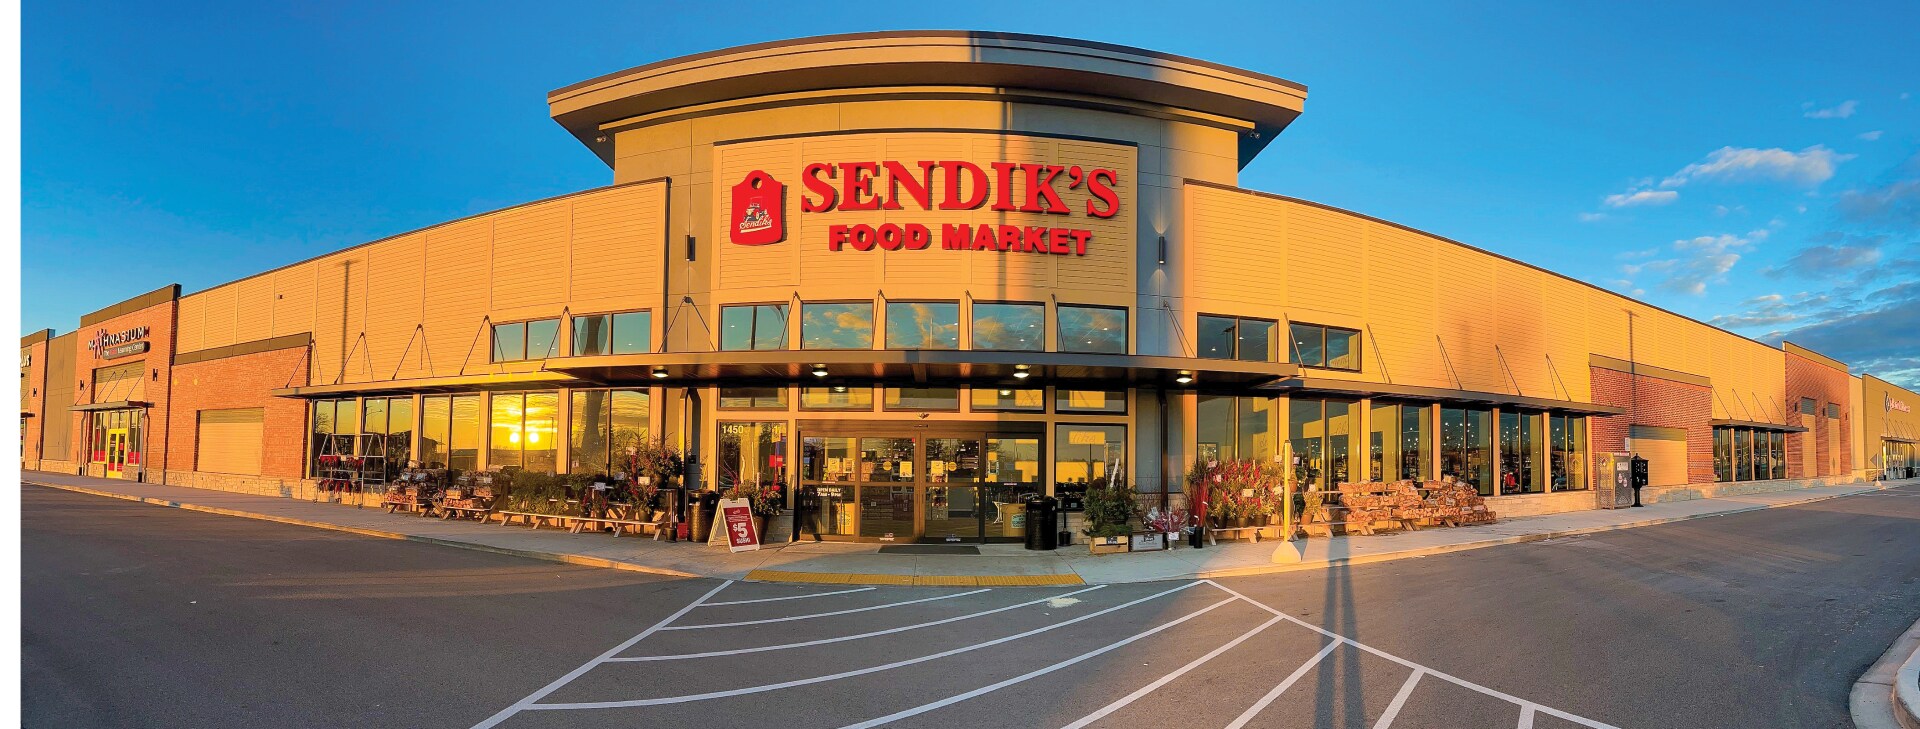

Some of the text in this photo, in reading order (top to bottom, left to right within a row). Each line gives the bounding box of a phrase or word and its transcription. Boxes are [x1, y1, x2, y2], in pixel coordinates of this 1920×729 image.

[801, 160, 1120, 219] SENDIK'S
[829, 223, 1092, 256] FOOD MARKET
[722, 425, 744, 434] 1450
